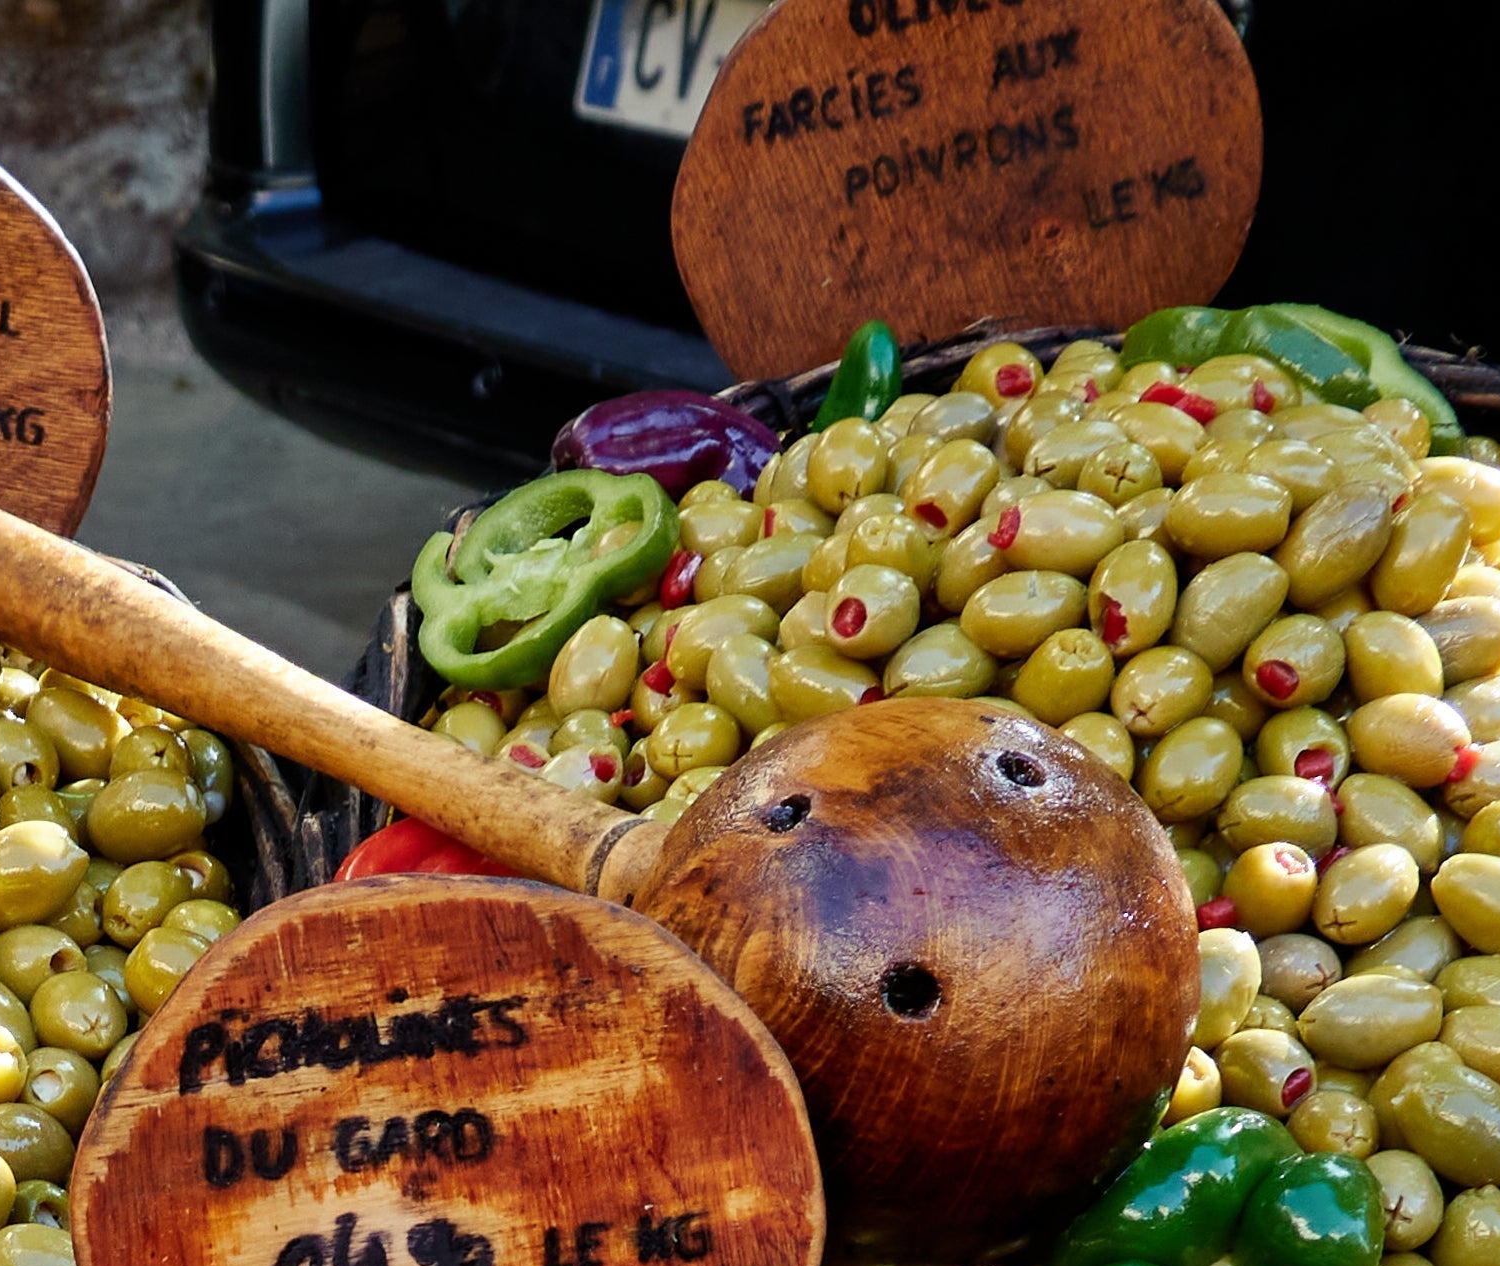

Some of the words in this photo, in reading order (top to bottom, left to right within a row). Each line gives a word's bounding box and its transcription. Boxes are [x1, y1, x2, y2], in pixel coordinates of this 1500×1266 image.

[743, 66, 922, 147] FARCIES
[992, 28, 1080, 90] AUX
[846, 103, 1079, 204] POIVRONS
[203, 1125, 298, 1188] DU
[333, 1107, 495, 1173] GARD
[635, 1211, 713, 1264] KG
